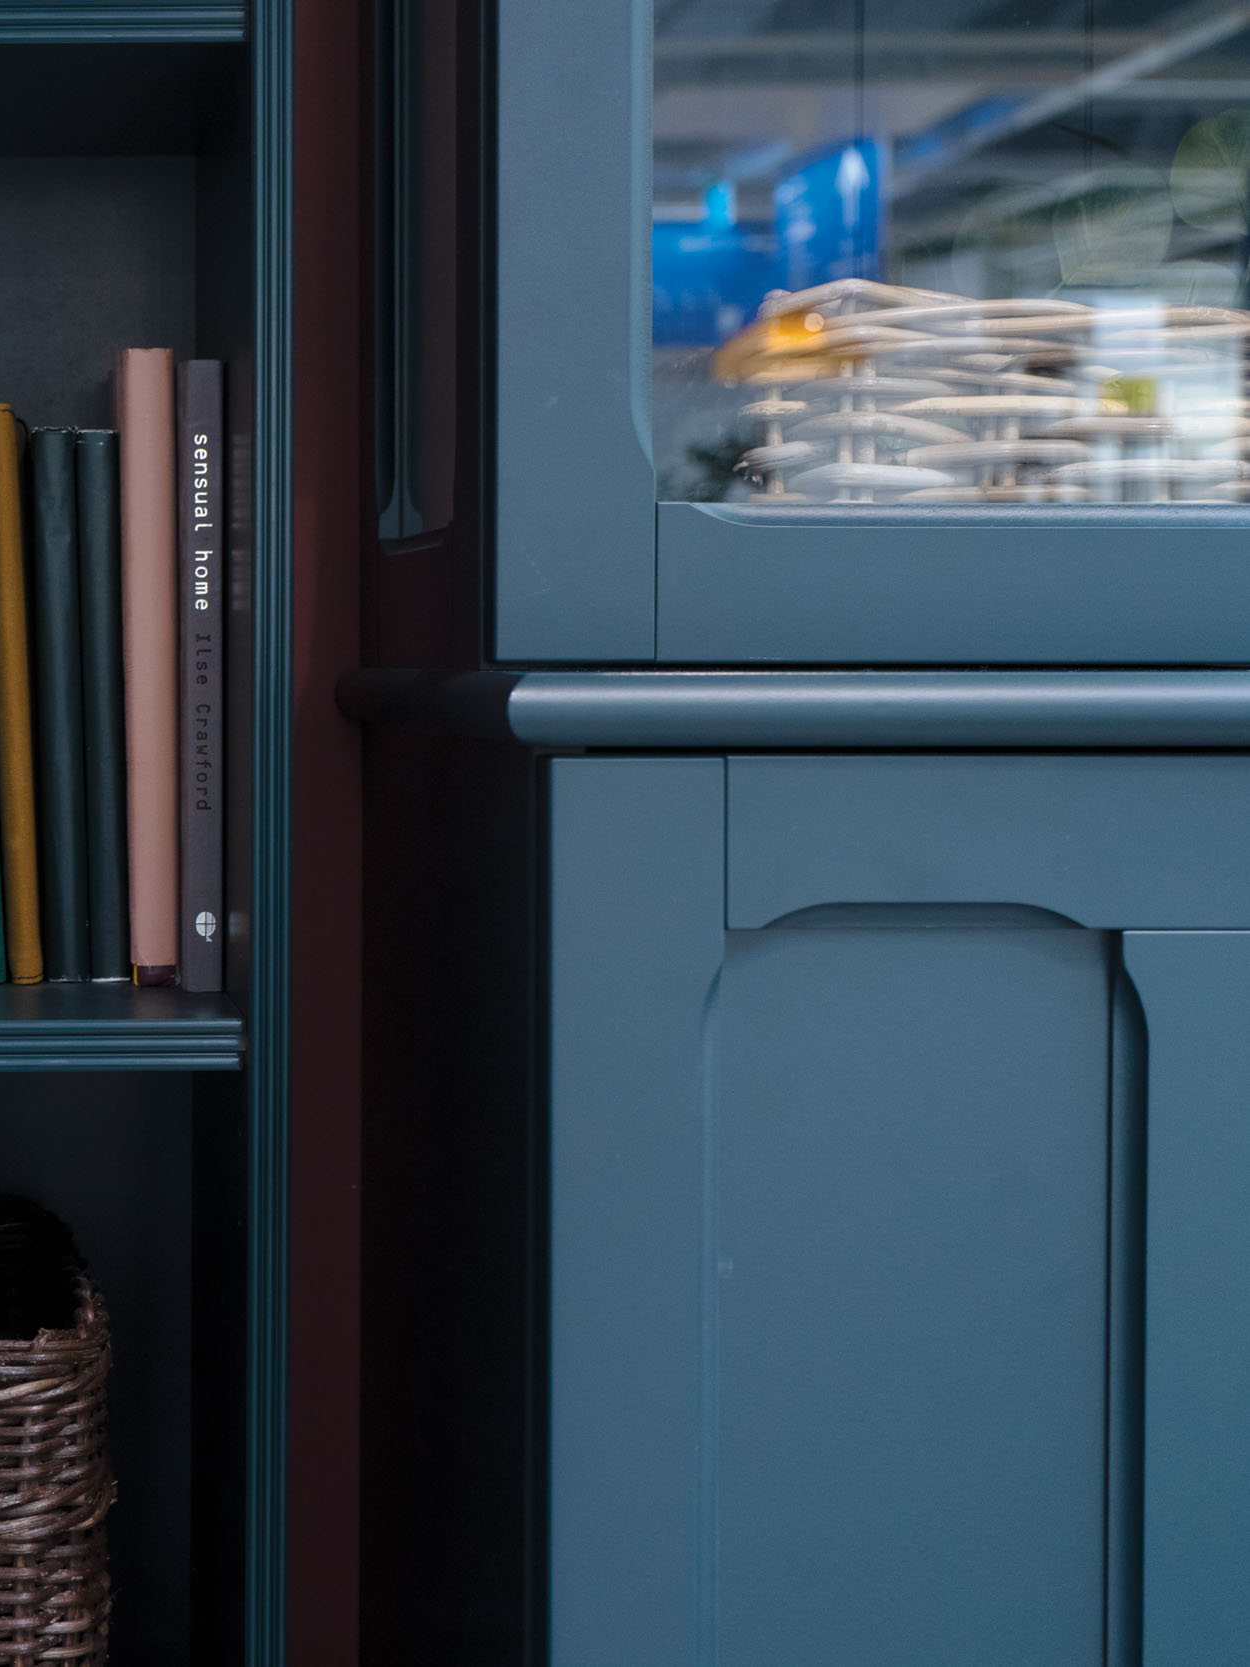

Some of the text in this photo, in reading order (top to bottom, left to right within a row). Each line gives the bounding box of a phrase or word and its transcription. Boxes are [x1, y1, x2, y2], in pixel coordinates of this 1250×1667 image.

[193, 434, 214, 612] sensual home
[194, 633, 212, 812] Ilse Crawford
